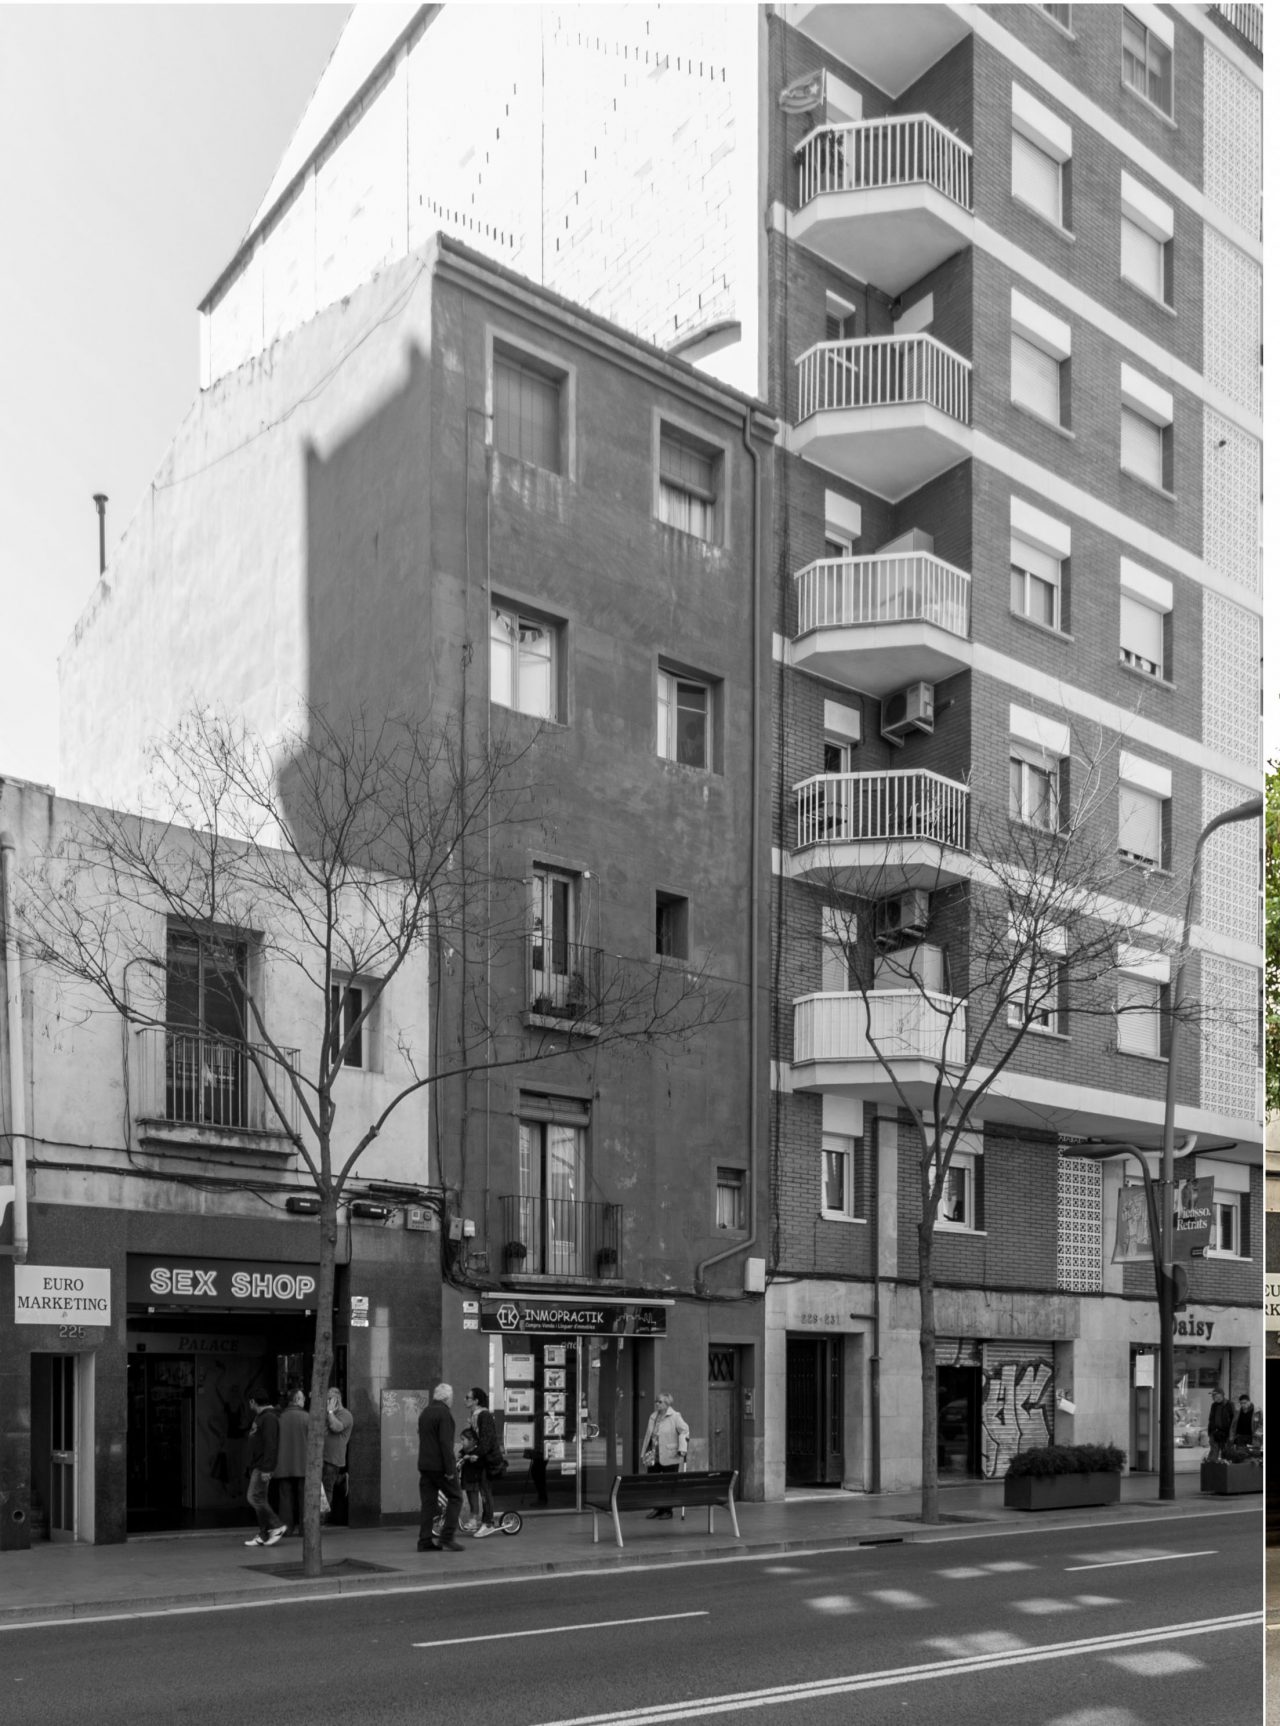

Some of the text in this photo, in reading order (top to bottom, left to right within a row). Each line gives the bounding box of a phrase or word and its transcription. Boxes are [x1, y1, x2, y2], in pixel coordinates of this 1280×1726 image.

[1176, 1218, 1208, 1231] Retrats
[43, 1277, 84, 1292] EURO
[150, 1267, 316, 1300] SEX SHOP
[17, 1296, 108, 1312] MARKETING
[524, 1309, 604, 1324] INMOPRACTIK
[59, 1325, 86, 1339] 225
[178, 1336, 240, 1352] PALACE
